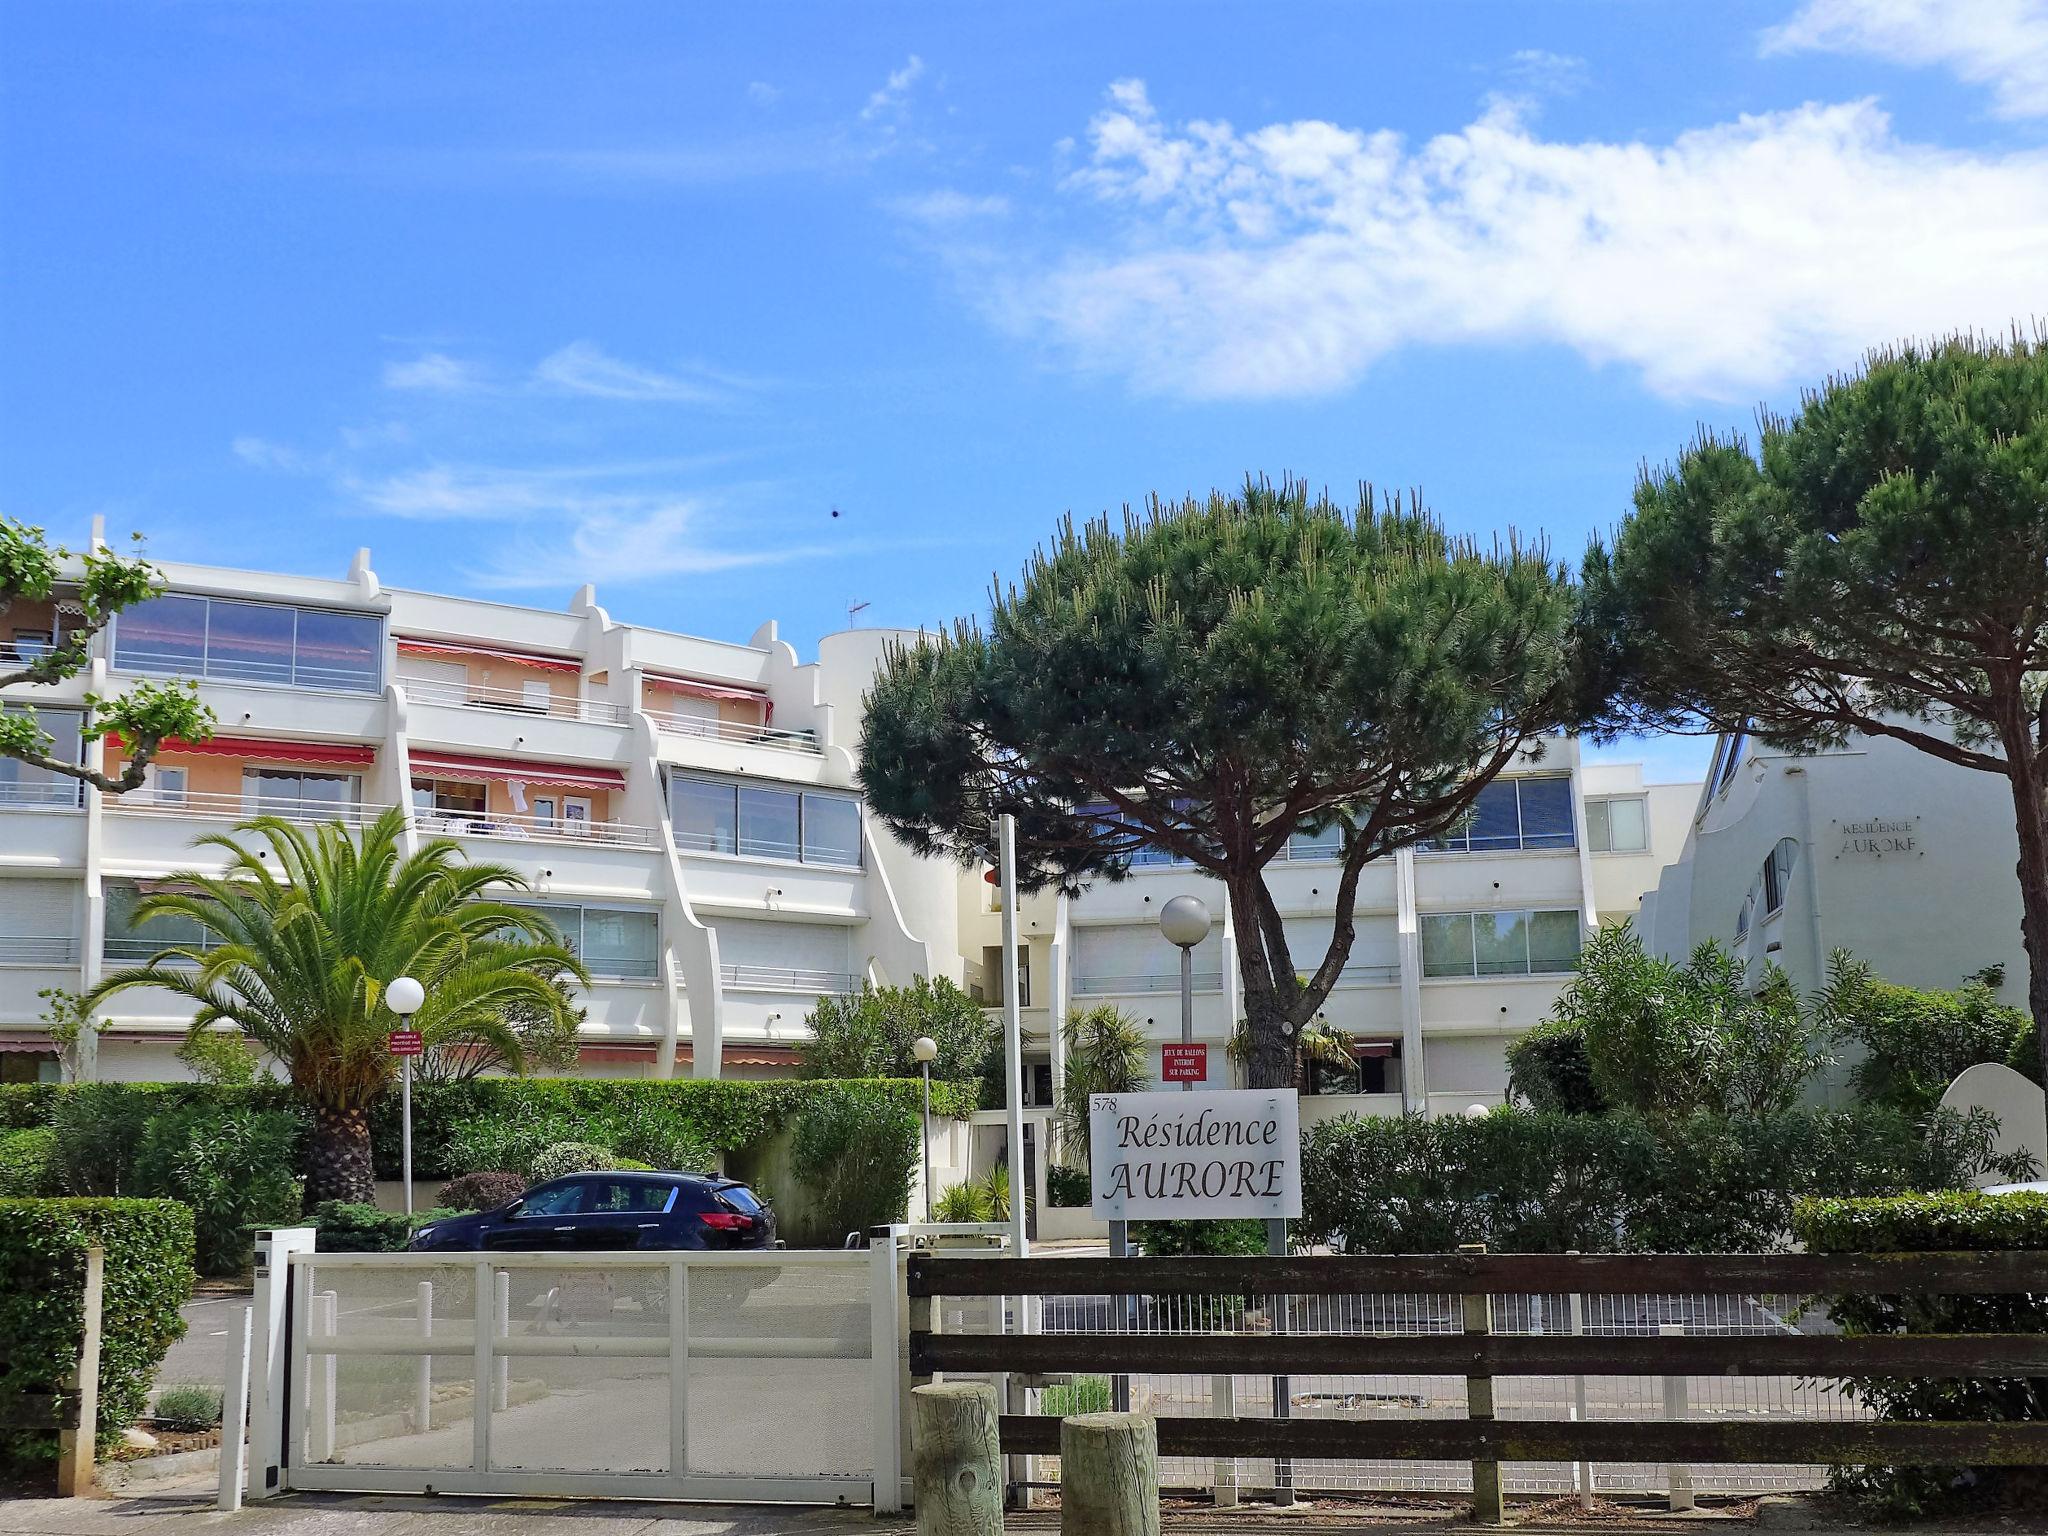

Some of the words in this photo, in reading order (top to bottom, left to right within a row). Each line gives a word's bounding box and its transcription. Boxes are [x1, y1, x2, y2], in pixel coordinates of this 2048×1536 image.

[1843, 822, 1912, 834] RESIDENCE
[1842, 837, 1916, 853] AURORE
[1179, 1068, 1200, 1076] PARKING
[1093, 1097, 1118, 1112] 578
[1116, 1109, 1278, 1148] Résidence
[1102, 1160, 1285, 1199] AURORE
